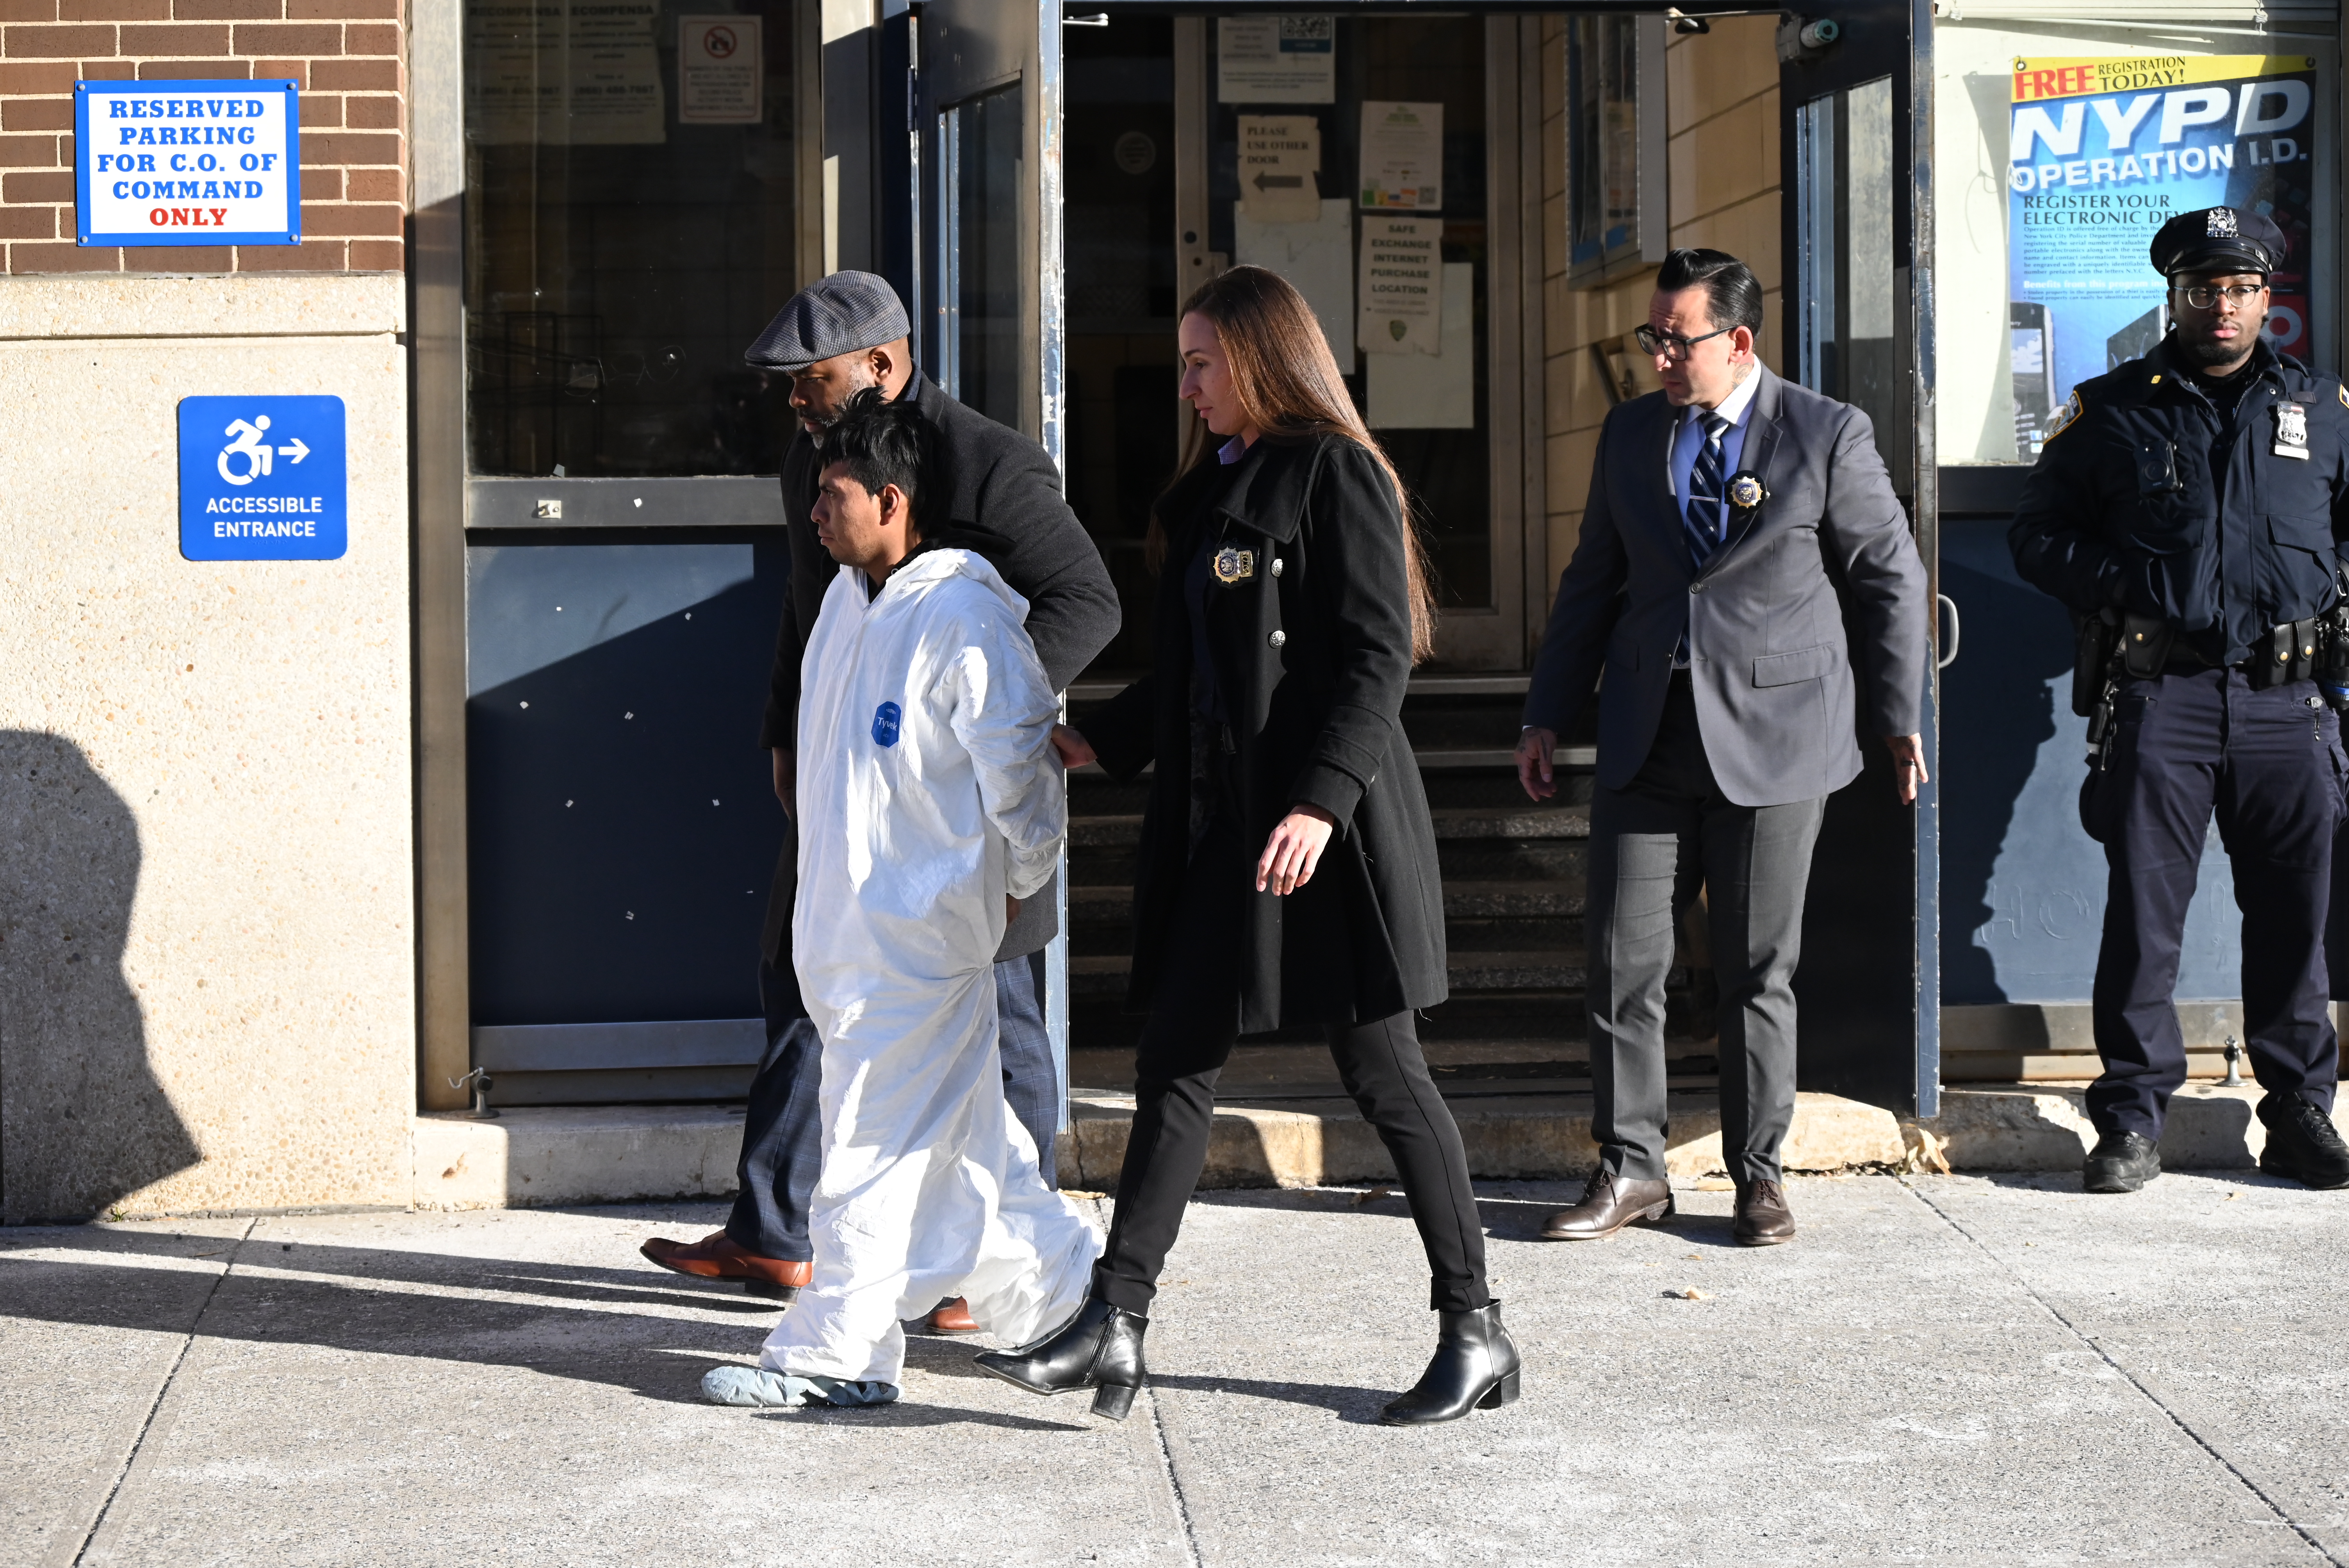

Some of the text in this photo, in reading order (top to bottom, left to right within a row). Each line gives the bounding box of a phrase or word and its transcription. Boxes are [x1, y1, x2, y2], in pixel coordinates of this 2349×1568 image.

[2015, 57, 2185, 100] FREE REGISTRATION
[2099, 69, 2185, 91] TODAY!
[109, 100, 264, 118] RESERVED
[2010, 80, 2311, 161] NYPD
[119, 127, 255, 145] PARKING
[1248, 127, 1287, 135] PLEASE
[1247, 141, 1308, 150] USE OTHER
[98, 153, 277, 172] FOR C.O. OF
[1247, 155, 1279, 164] DOOR
[2010, 138, 2308, 192] OPERATION I.D.
[113, 181, 263, 199] COMMAND
[2024, 195, 2170, 208] REGISTER YOUR
[150, 208, 228, 226] ONLY
[2024, 211, 2141, 225] ELECTRONIC
[1388, 225, 1416, 234] SAFE
[1372, 239, 1431, 249] EXCHANGE
[1374, 254, 1428, 264] INTERNET
[1371, 268, 1430, 279] PURCHASE
[1372, 284, 1428, 294] LOCATION
[2024, 280, 2061, 288] Benefits
[2089, 280, 2106, 288] this
[2109, 281, 2148, 290] program
[206, 497, 322, 513] ACCESSIBLE
[214, 521, 315, 537] ENTRANCE
[878, 717, 897, 731] Tyvek
